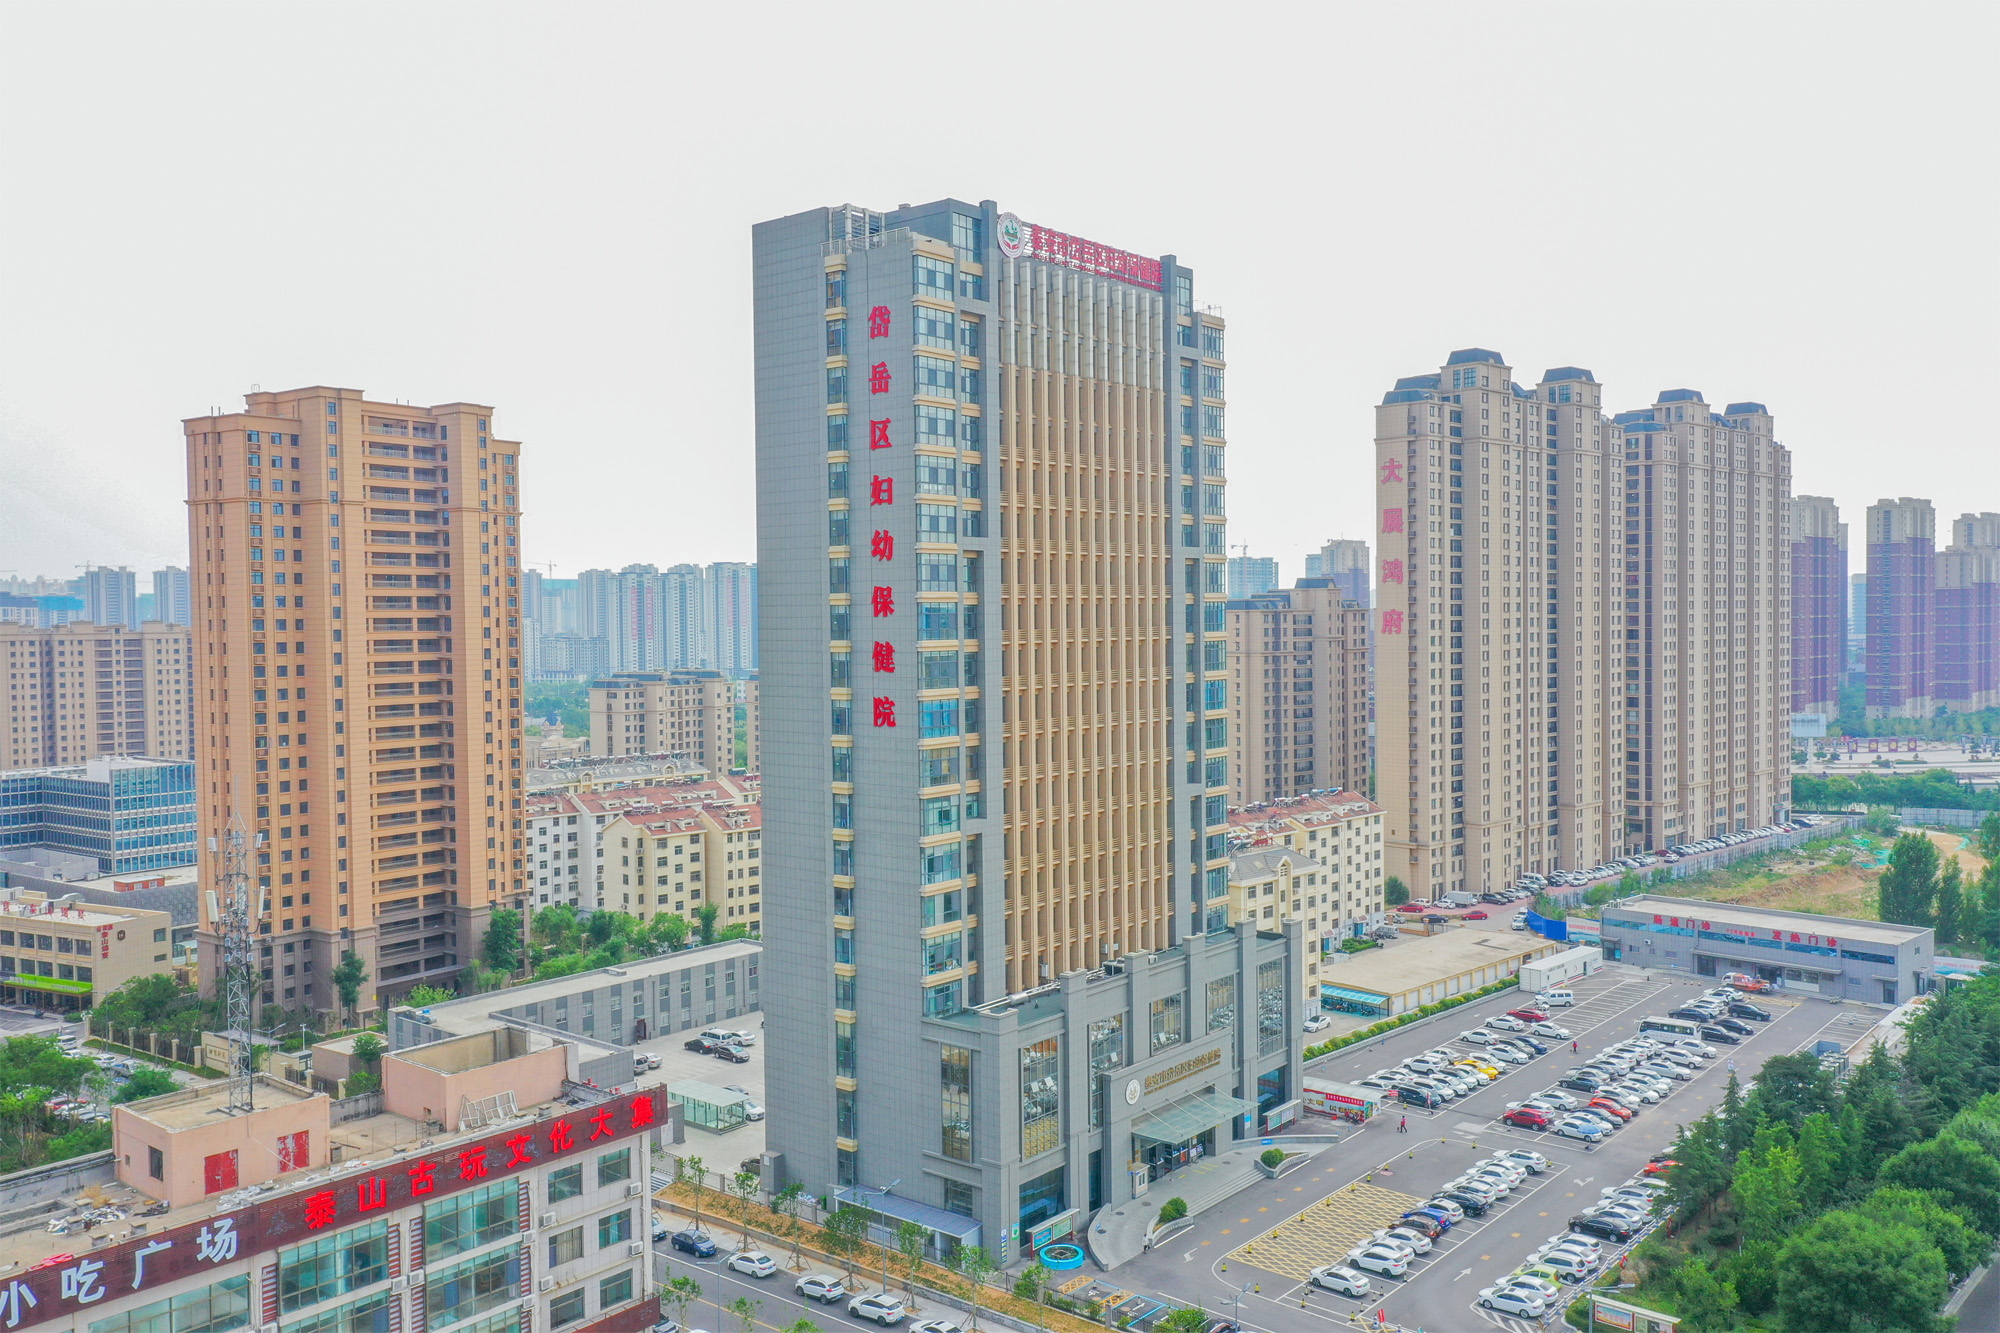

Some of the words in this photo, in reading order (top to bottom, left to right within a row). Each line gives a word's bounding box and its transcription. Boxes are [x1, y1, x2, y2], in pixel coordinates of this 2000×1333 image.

[868, 305, 897, 728] 岱岳区妇幼保健院
[1381, 458, 1404, 635] 大展鸿府
[1653, 914, 1711, 931] 肠道门诊
[1772, 930, 1837, 948] 发热门诊
[305, 1095, 654, 1230] 泰山古玩文化大集
[0, 1218, 238, 1329] 小吃广场
